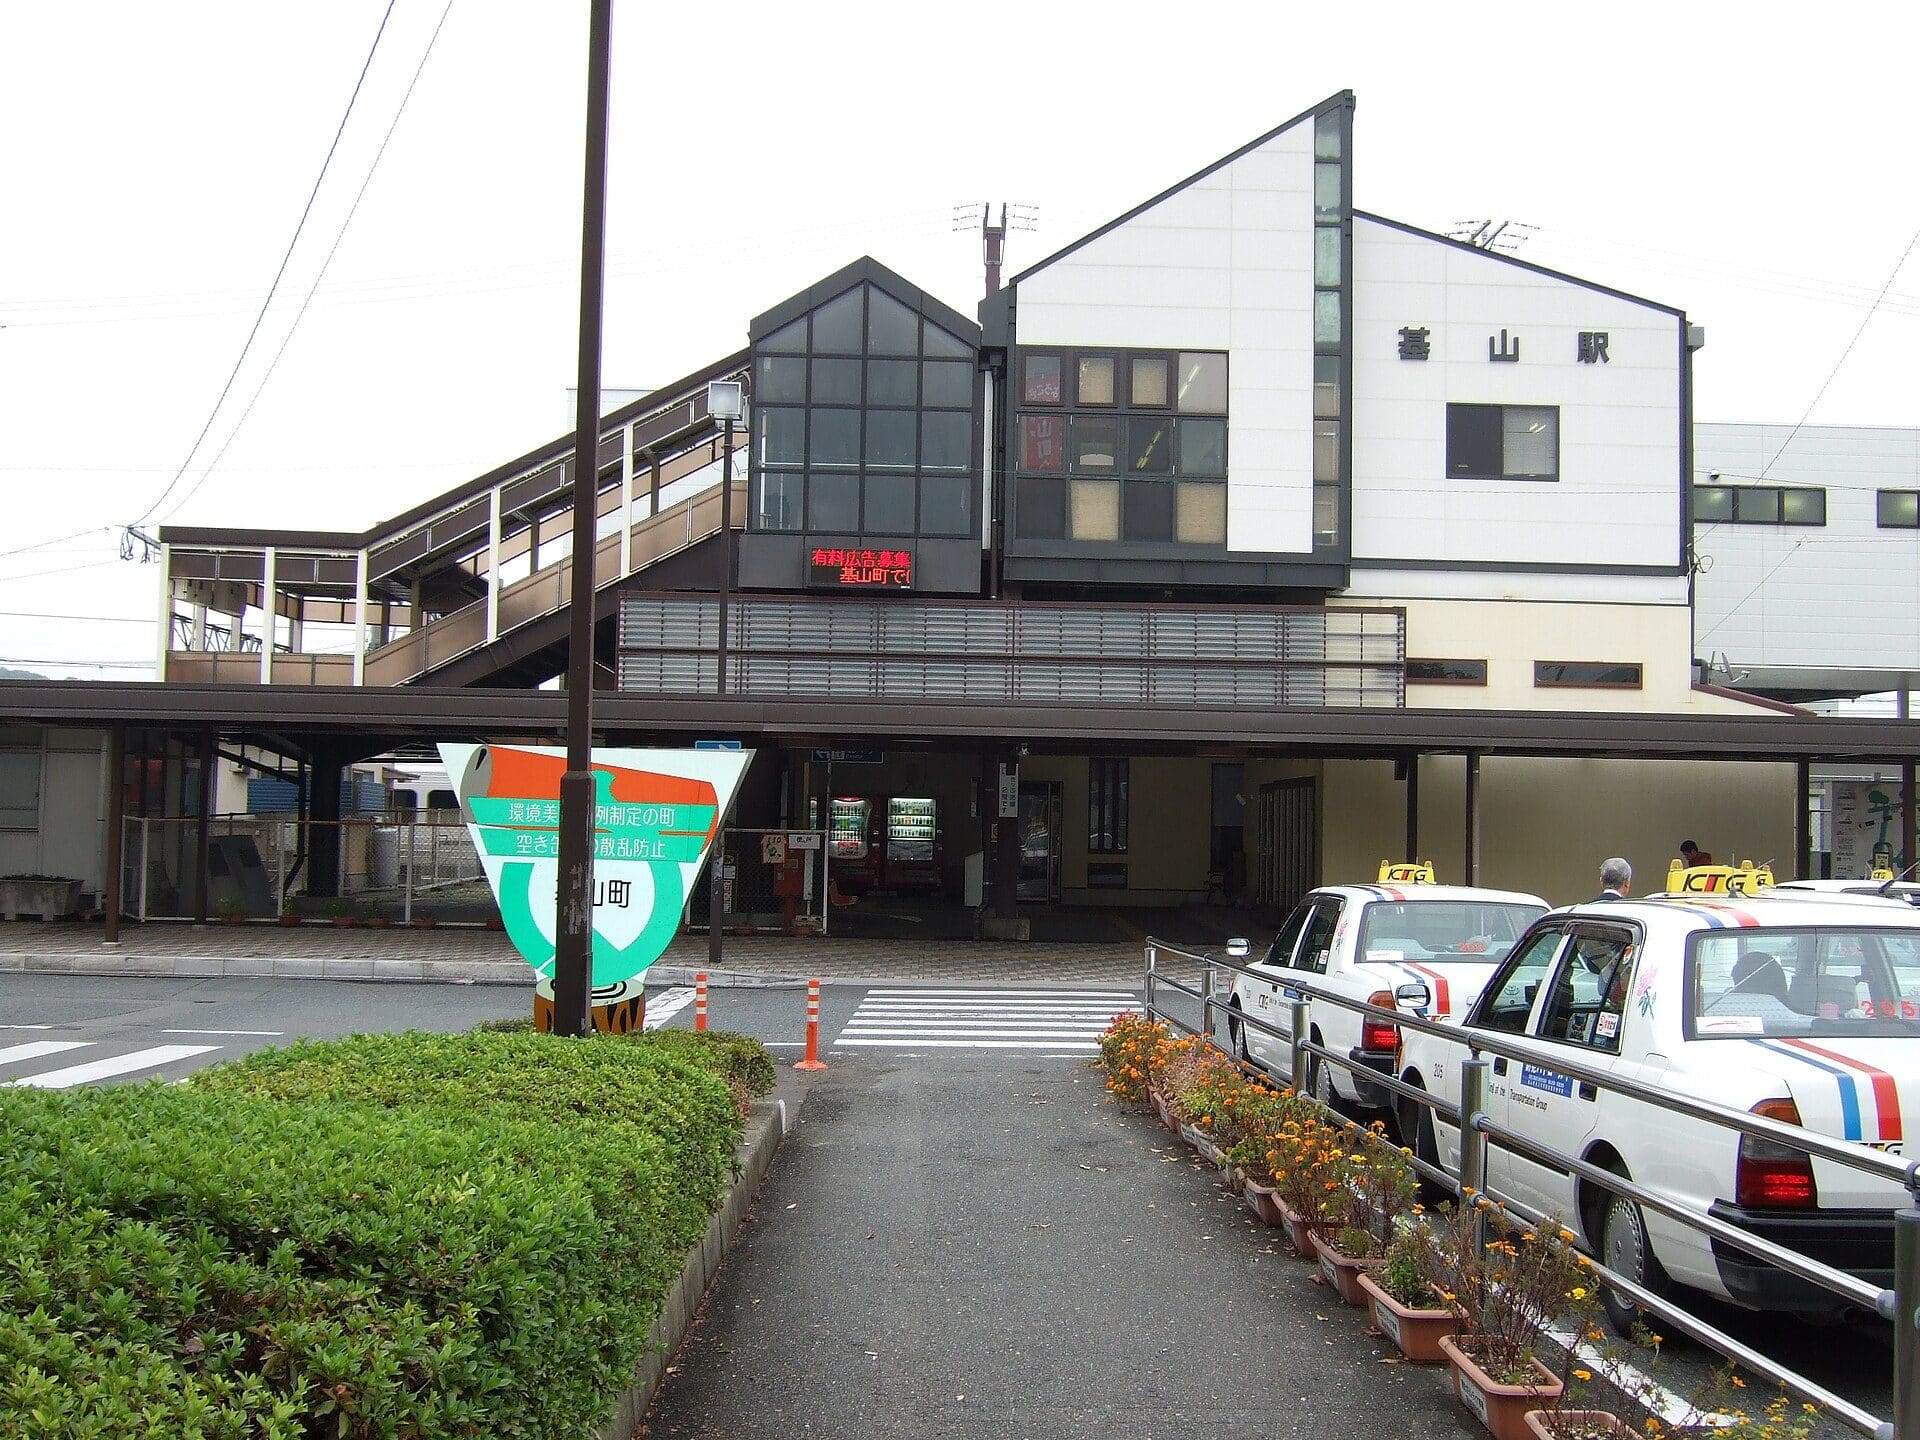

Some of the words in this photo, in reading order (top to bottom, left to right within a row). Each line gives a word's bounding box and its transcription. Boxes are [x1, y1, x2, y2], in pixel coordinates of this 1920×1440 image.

[812, 549, 911, 567] 有料広告募集
[509, 802, 675, 827] 環境美例制定の町
[1861, 999, 1915, 1018] 205
